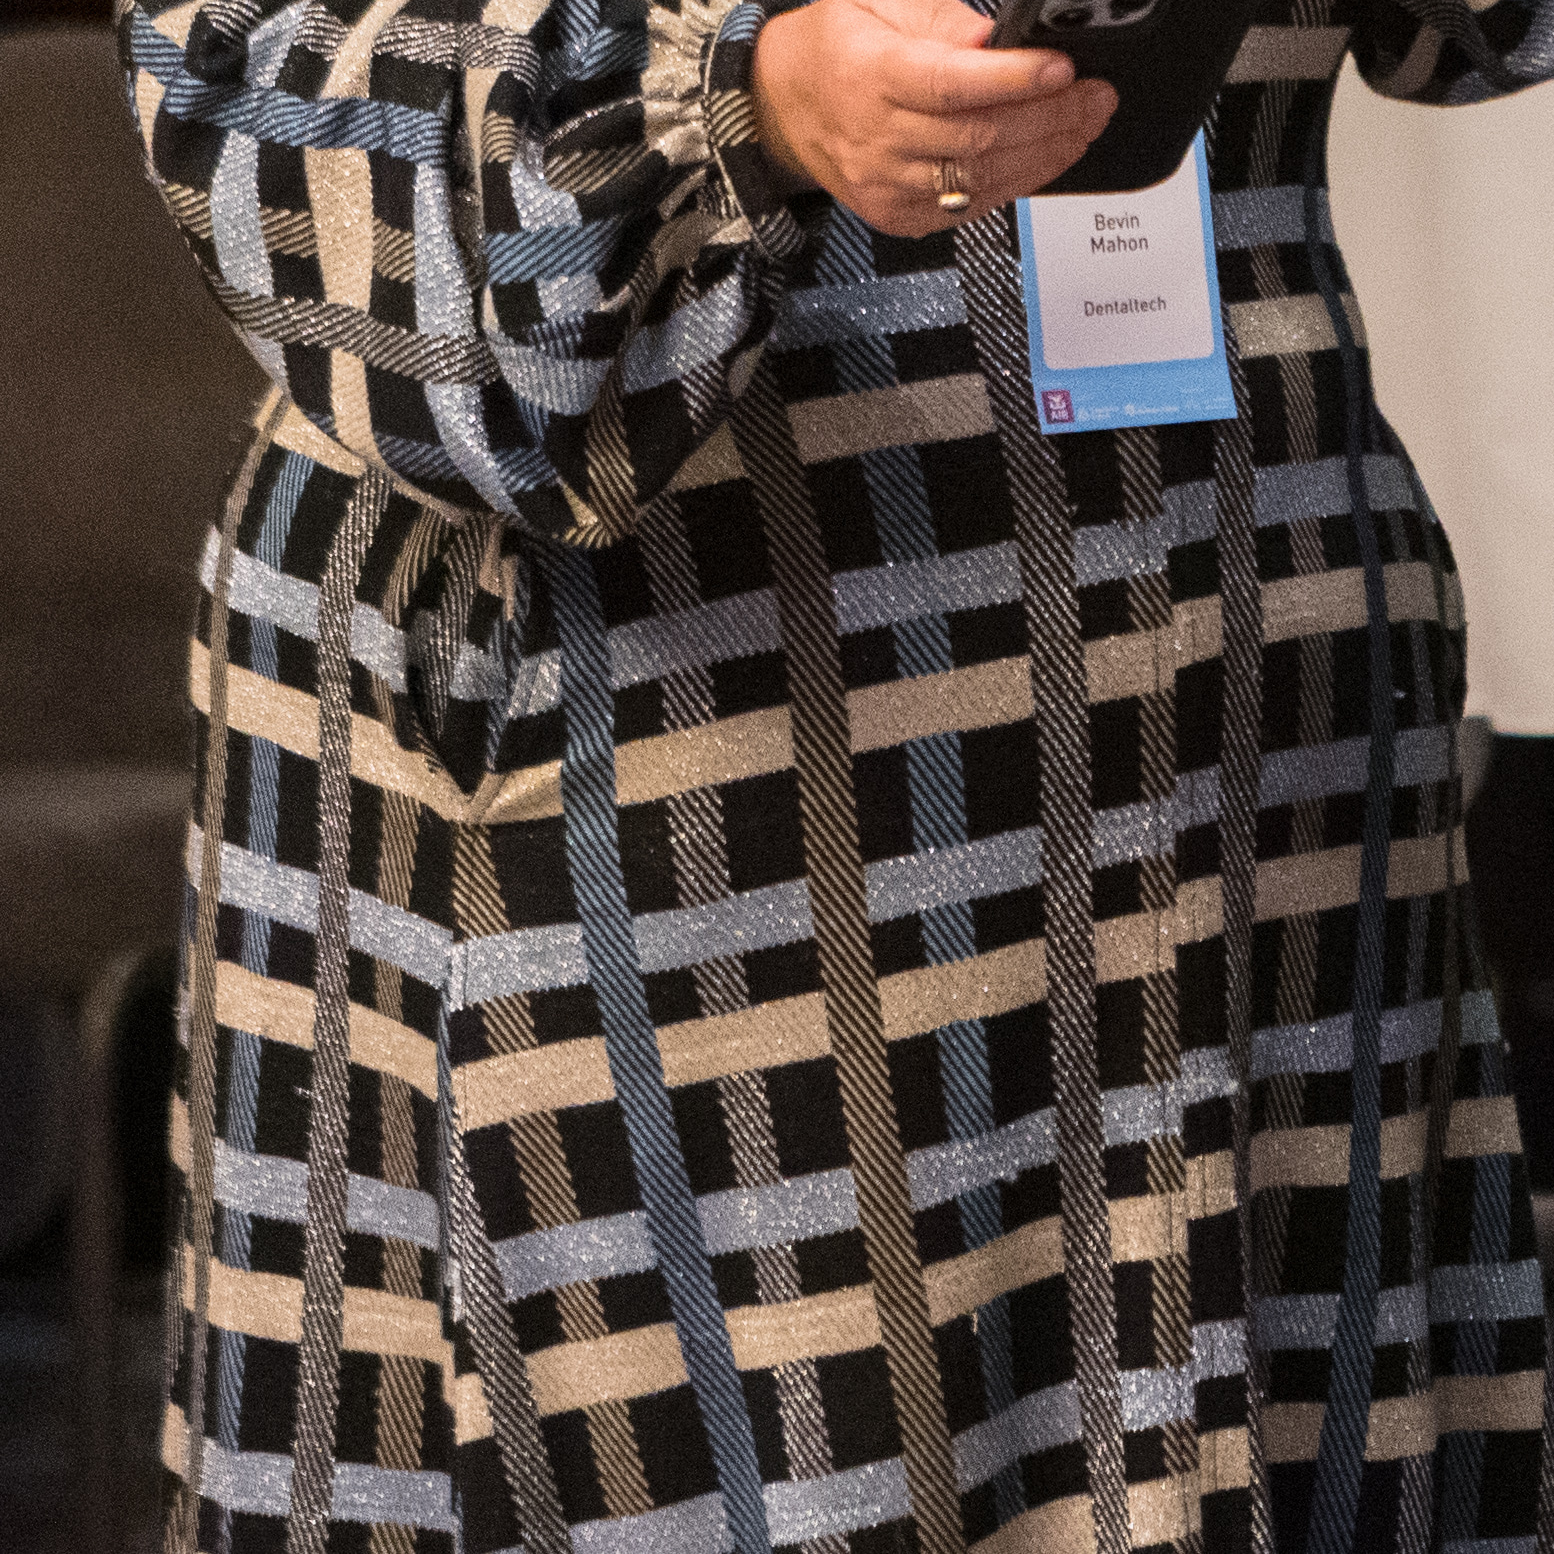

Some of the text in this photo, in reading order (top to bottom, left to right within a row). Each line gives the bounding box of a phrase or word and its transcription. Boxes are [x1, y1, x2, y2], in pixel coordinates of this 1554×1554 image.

[1094, 212, 1140, 231] Bevin
[1090, 235, 1149, 254] Mahon
[1083, 297, 1167, 317] Dentaltech
